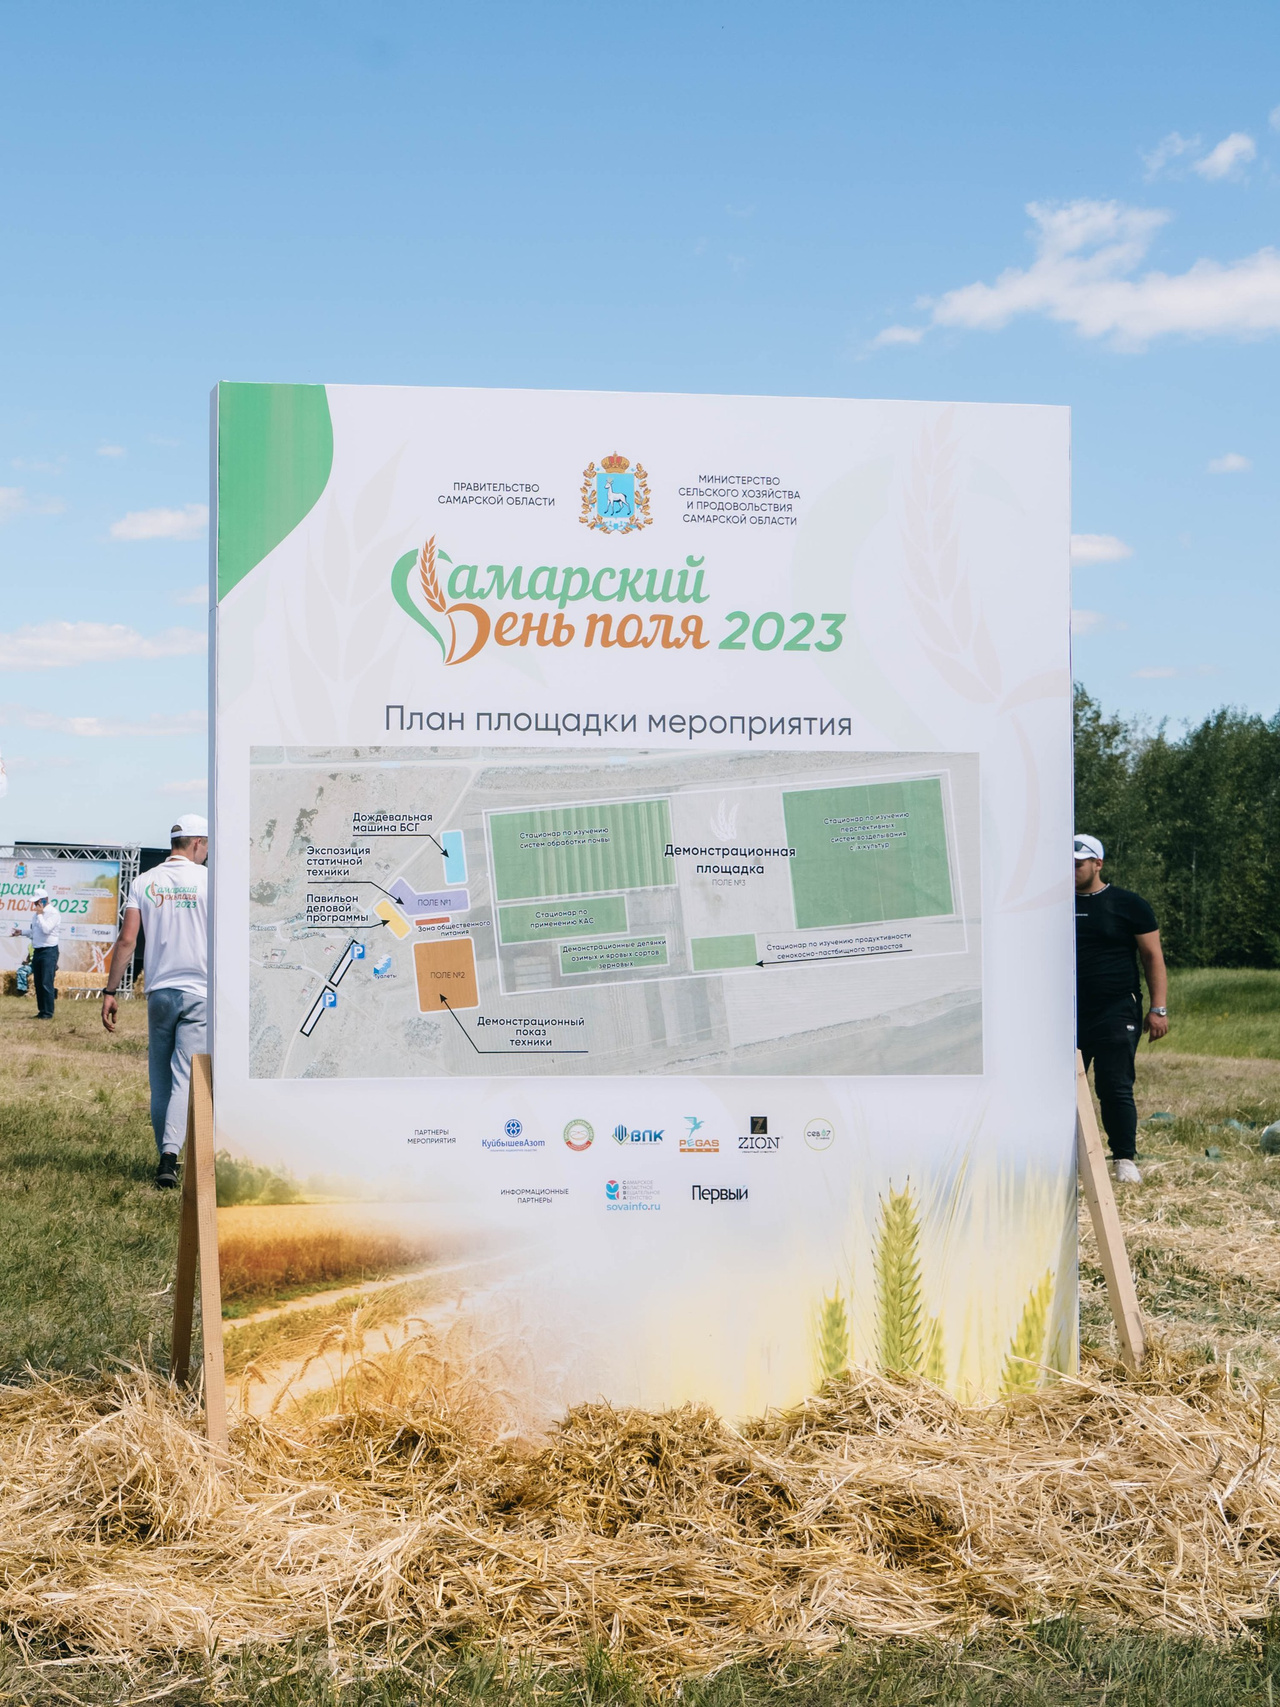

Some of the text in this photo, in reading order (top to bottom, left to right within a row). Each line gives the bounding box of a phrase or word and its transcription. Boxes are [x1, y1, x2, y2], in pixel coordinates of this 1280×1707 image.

[698, 475, 780, 486] МИНИСТЕРСТВО
[453, 482, 540, 492] ПРАВИТЕЛЬСТВО
[678, 487, 800, 500] СЕЛЬСКОГО ХОЗЯЙСТВА
[438, 493, 555, 506] САМАРСКОЙ ОБЛАСТИ
[686, 501, 793, 513] И ПРОДОВОЛЬСТВИЯ
[682, 512, 797, 526] САМАРСКОЙ ОБЛАСТИ
[584, 612, 710, 650] поля
[718, 611, 847, 652] 2023
[385, 705, 853, 740] План площадки мероприятия
[352, 812, 432, 824] Дождевальная
[823, 816, 864, 825] Стационар
[353, 823, 420, 832] машина БСГ
[519, 831, 561, 839] Стационар
[573, 827, 609, 836] изучению
[547, 839, 586, 847] обработки
[306, 846, 371, 857] Экспозиция
[664, 844, 796, 859] Демонстрационная
[306, 855, 363, 866] статичной
[306, 867, 350, 876] техники
[696, 865, 764, 875] площадка
[733, 879, 746, 887] №3
[306, 893, 359, 904] Павильон
[50, 898, 90, 914] 2023
[175, 901, 197, 909] 2023
[306, 903, 352, 914] деловой
[306, 913, 369, 924] программы
[535, 910, 577, 919] Стационар
[418, 920, 491, 933] Зона общественного
[530, 917, 595, 929] применению КАС
[440, 929, 470, 937] питания
[562, 940, 667, 954] Демонстрационные делянки
[766, 942, 808, 951] Стационар
[819, 938, 853, 947] изучению
[854, 933, 912, 944] продуктивности
[571, 954, 598, 962] озимых
[606, 952, 633, 960] яровых
[634, 949, 660, 957] сортов
[777, 943, 903, 960] сенокосно-пастбищного травостоя
[598, 961, 634, 970] зерновых
[430, 971, 466, 979] ПОЛЕ №2
[477, 1016, 585, 1028] Демонстрационный
[515, 1028, 547, 1036] показ
[509, 1038, 553, 1047] техники
[407, 1137, 457, 1145] МЕРОПРИЯТИЯ
[630, 1129, 666, 1142] ВПК
[481, 1138, 546, 1149] КуйбышевАзот
[679, 1138, 720, 1148] PEGAS
[738, 1136, 781, 1149] ZION
[500, 1188, 570, 1196] ИНФОРМАЦИОННЫЕ
[692, 1184, 749, 1205] Первый
[606, 1201, 661, 1211] sovainfo.ru
